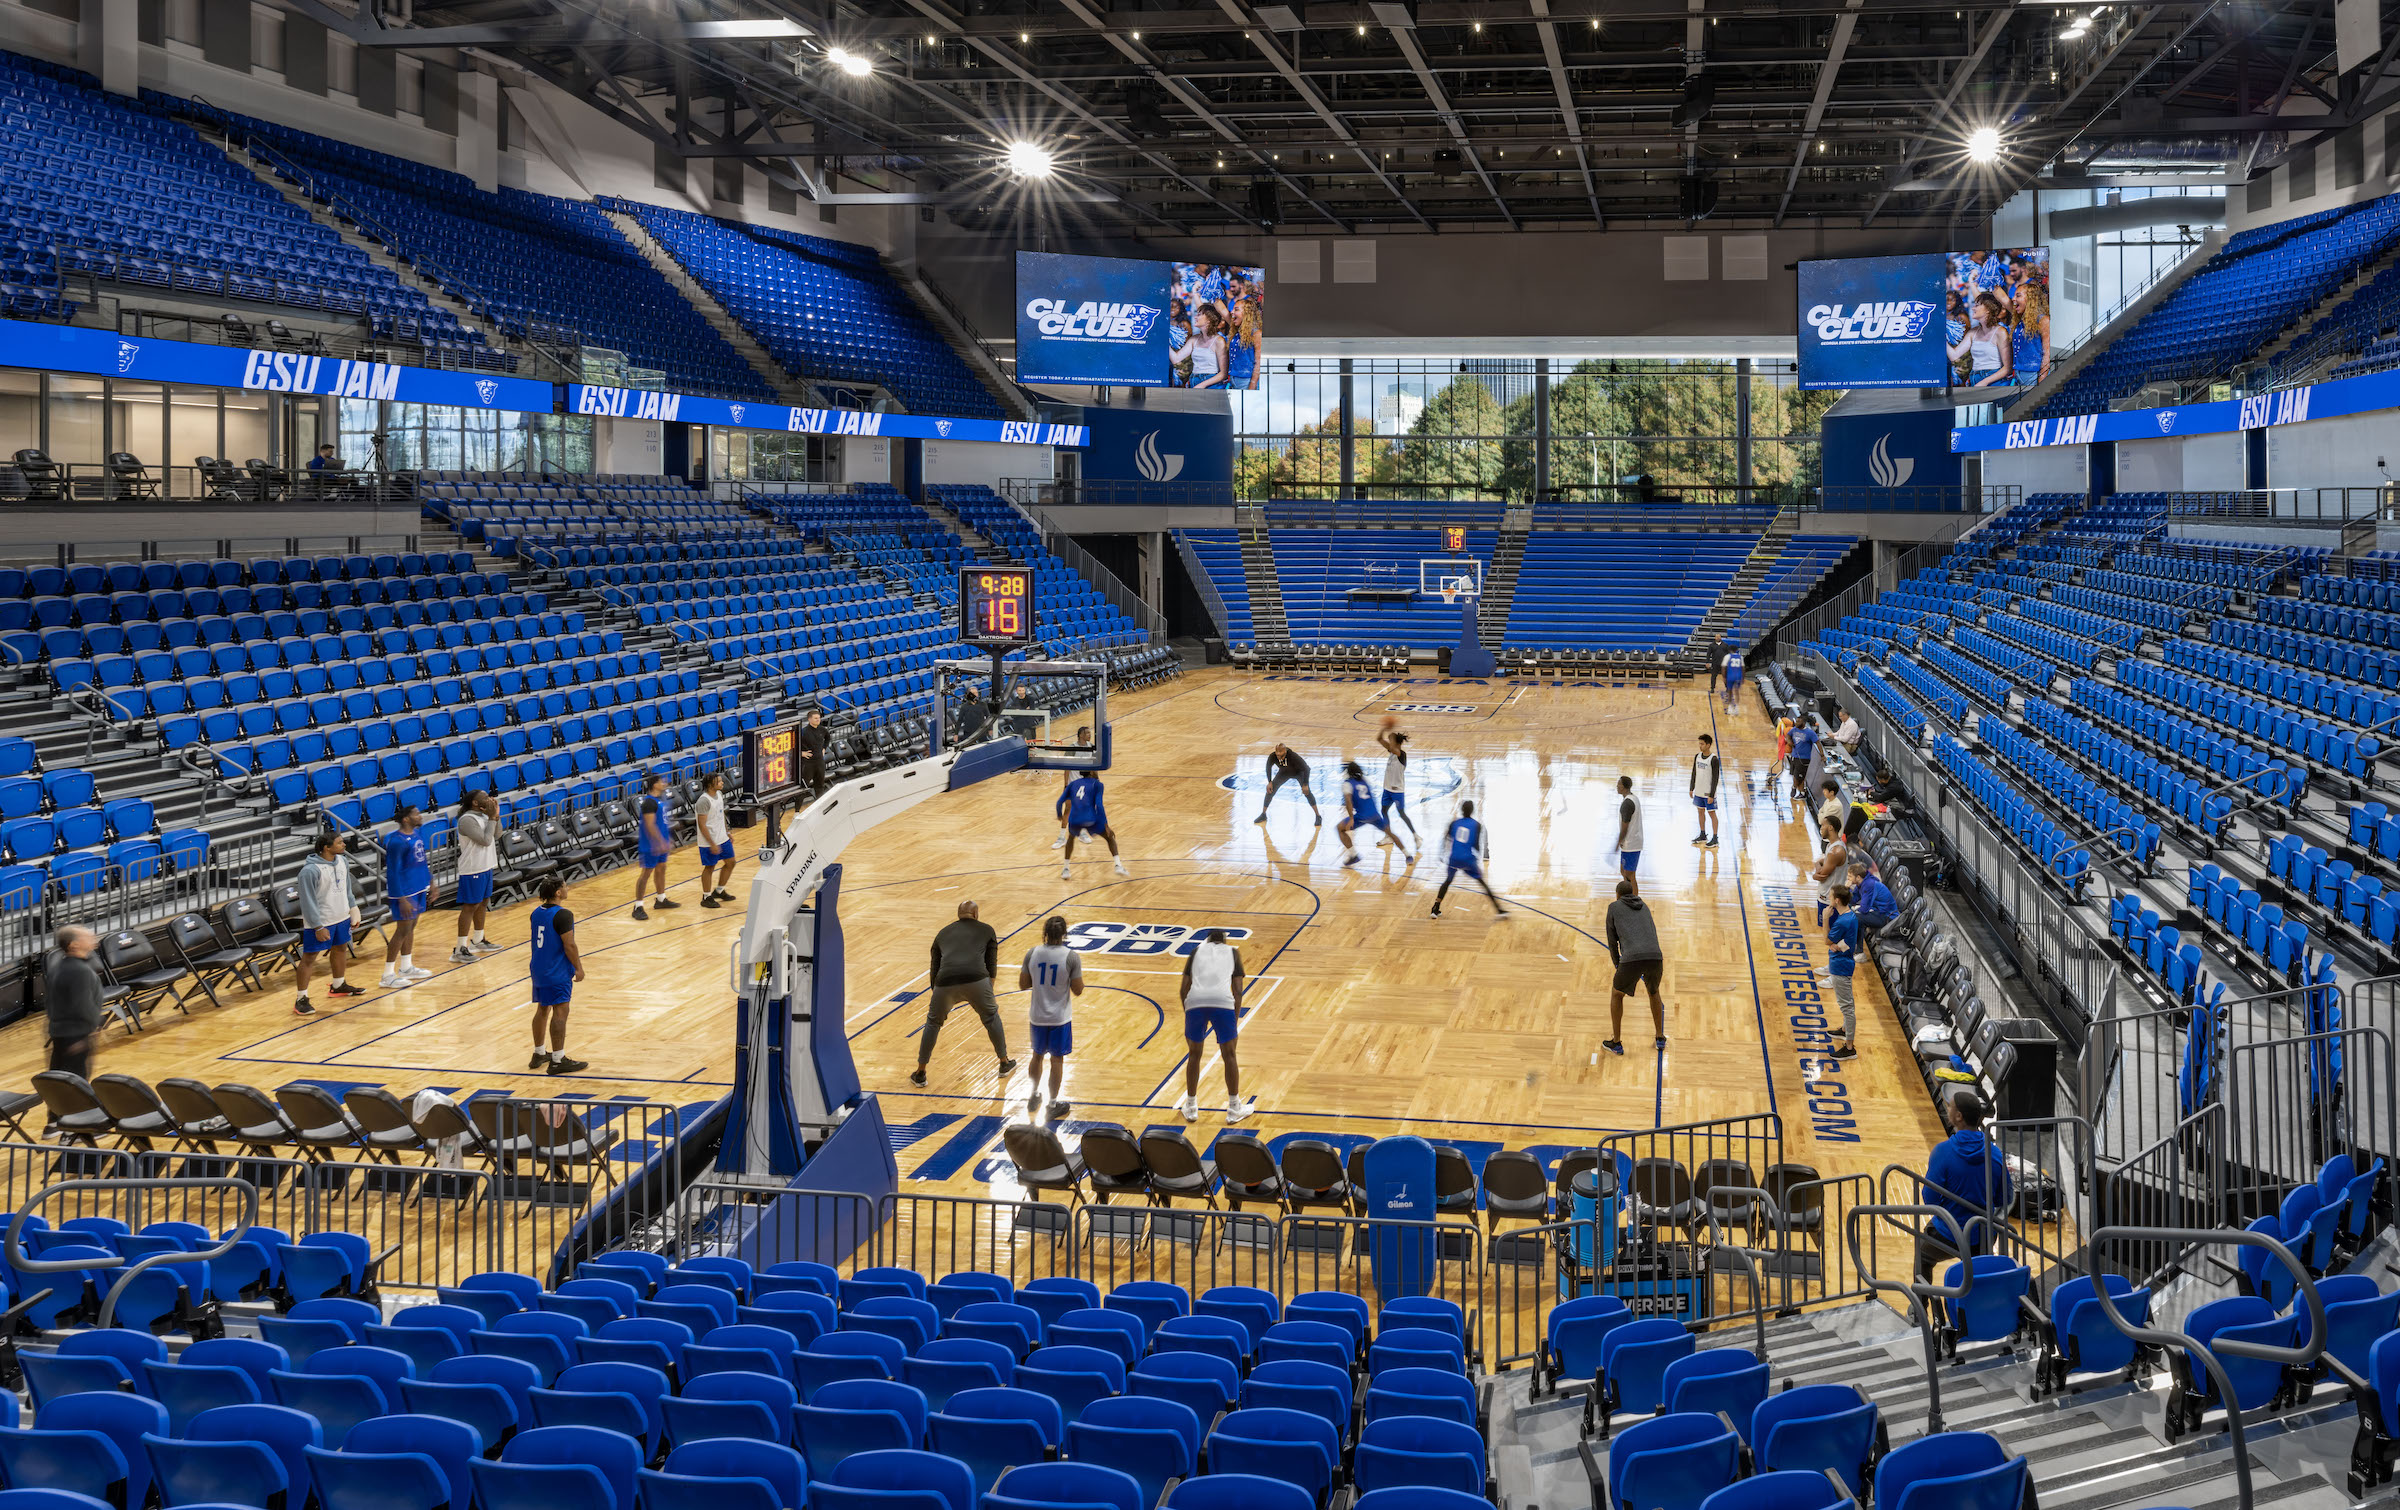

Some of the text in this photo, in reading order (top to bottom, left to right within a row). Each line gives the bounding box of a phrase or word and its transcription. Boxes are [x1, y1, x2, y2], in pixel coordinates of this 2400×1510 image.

[1026, 298, 1134, 322] CLAW
[1807, 301, 1908, 326] CLAW
[1038, 313, 1134, 338] CLUB
[1818, 316, 1910, 340] CLUB
[243, 349, 401, 401] GSU JAM
[578, 385, 681, 422] GSU JAM
[2238, 386, 2312, 431] GSU JAM
[788, 407, 883, 437] GSU JAM
[1000, 420, 1083, 447] GSU JAM
[2004, 414, 2098, 449] GSU JAM
[1262, 675, 1490, 687] GEORGIA
[1075, 785, 1085, 800] 4
[1358, 784, 1370, 799] 2
[786, 849, 818, 898] SPALDING
[536, 925, 545, 949] 5
[1037, 962, 1059, 987] 11
[1762, 885, 1861, 1143] GEORGIASTATESPORTS.COM
[1387, 1200, 1414, 1209] Gilman
[1618, 1263, 1663, 1273] POWE THROGH
[2364, 1416, 2373, 1430] 5
